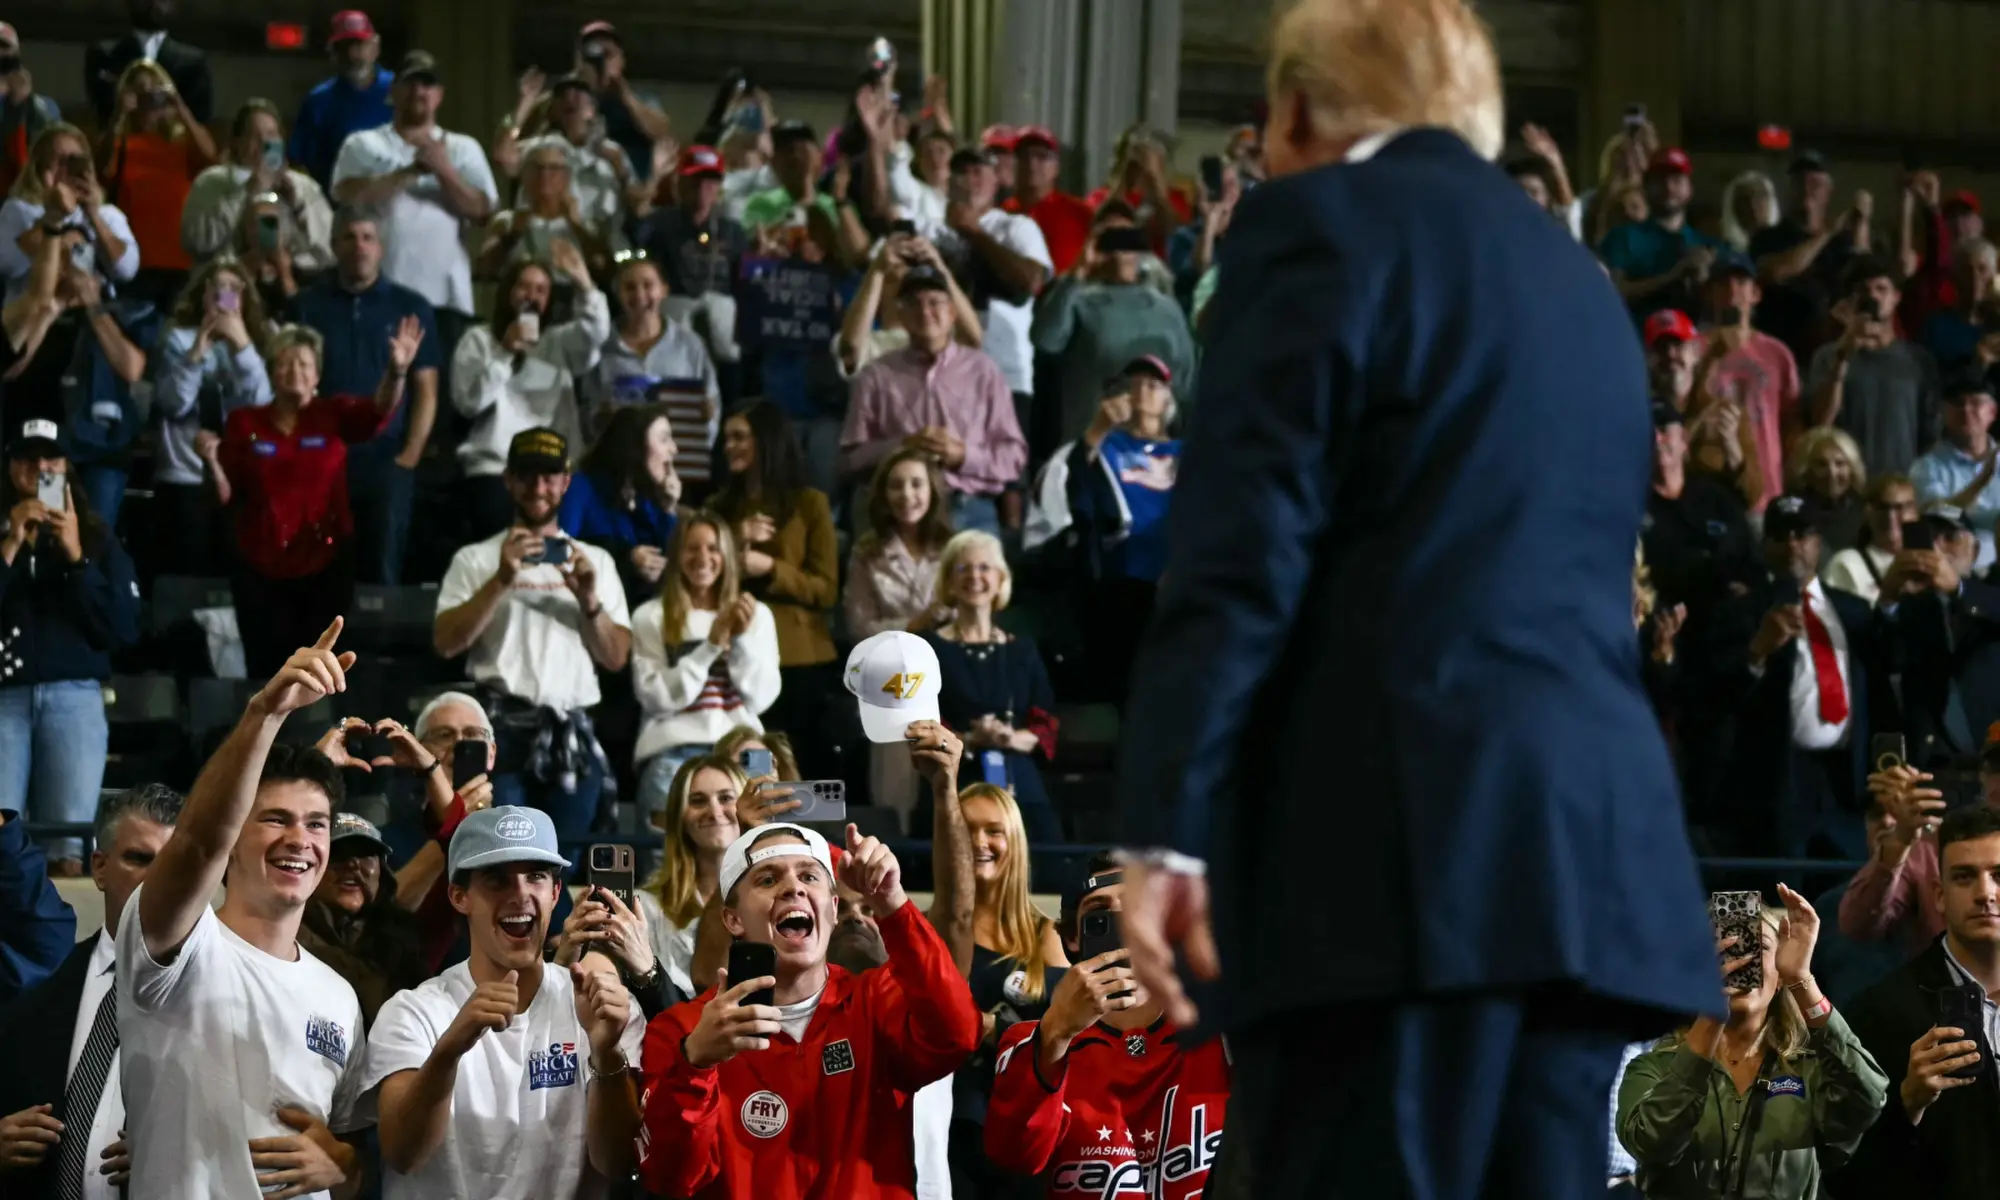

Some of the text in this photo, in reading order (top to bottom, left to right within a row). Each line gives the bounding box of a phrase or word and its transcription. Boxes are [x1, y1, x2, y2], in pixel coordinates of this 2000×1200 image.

[880, 671, 925, 699] 47
[499, 820, 532, 830] FRICK
[531, 1055, 576, 1074] FRCK
[750, 1100, 781, 1118] FRY
[1080, 1145, 1156, 1160] WASHINGON
